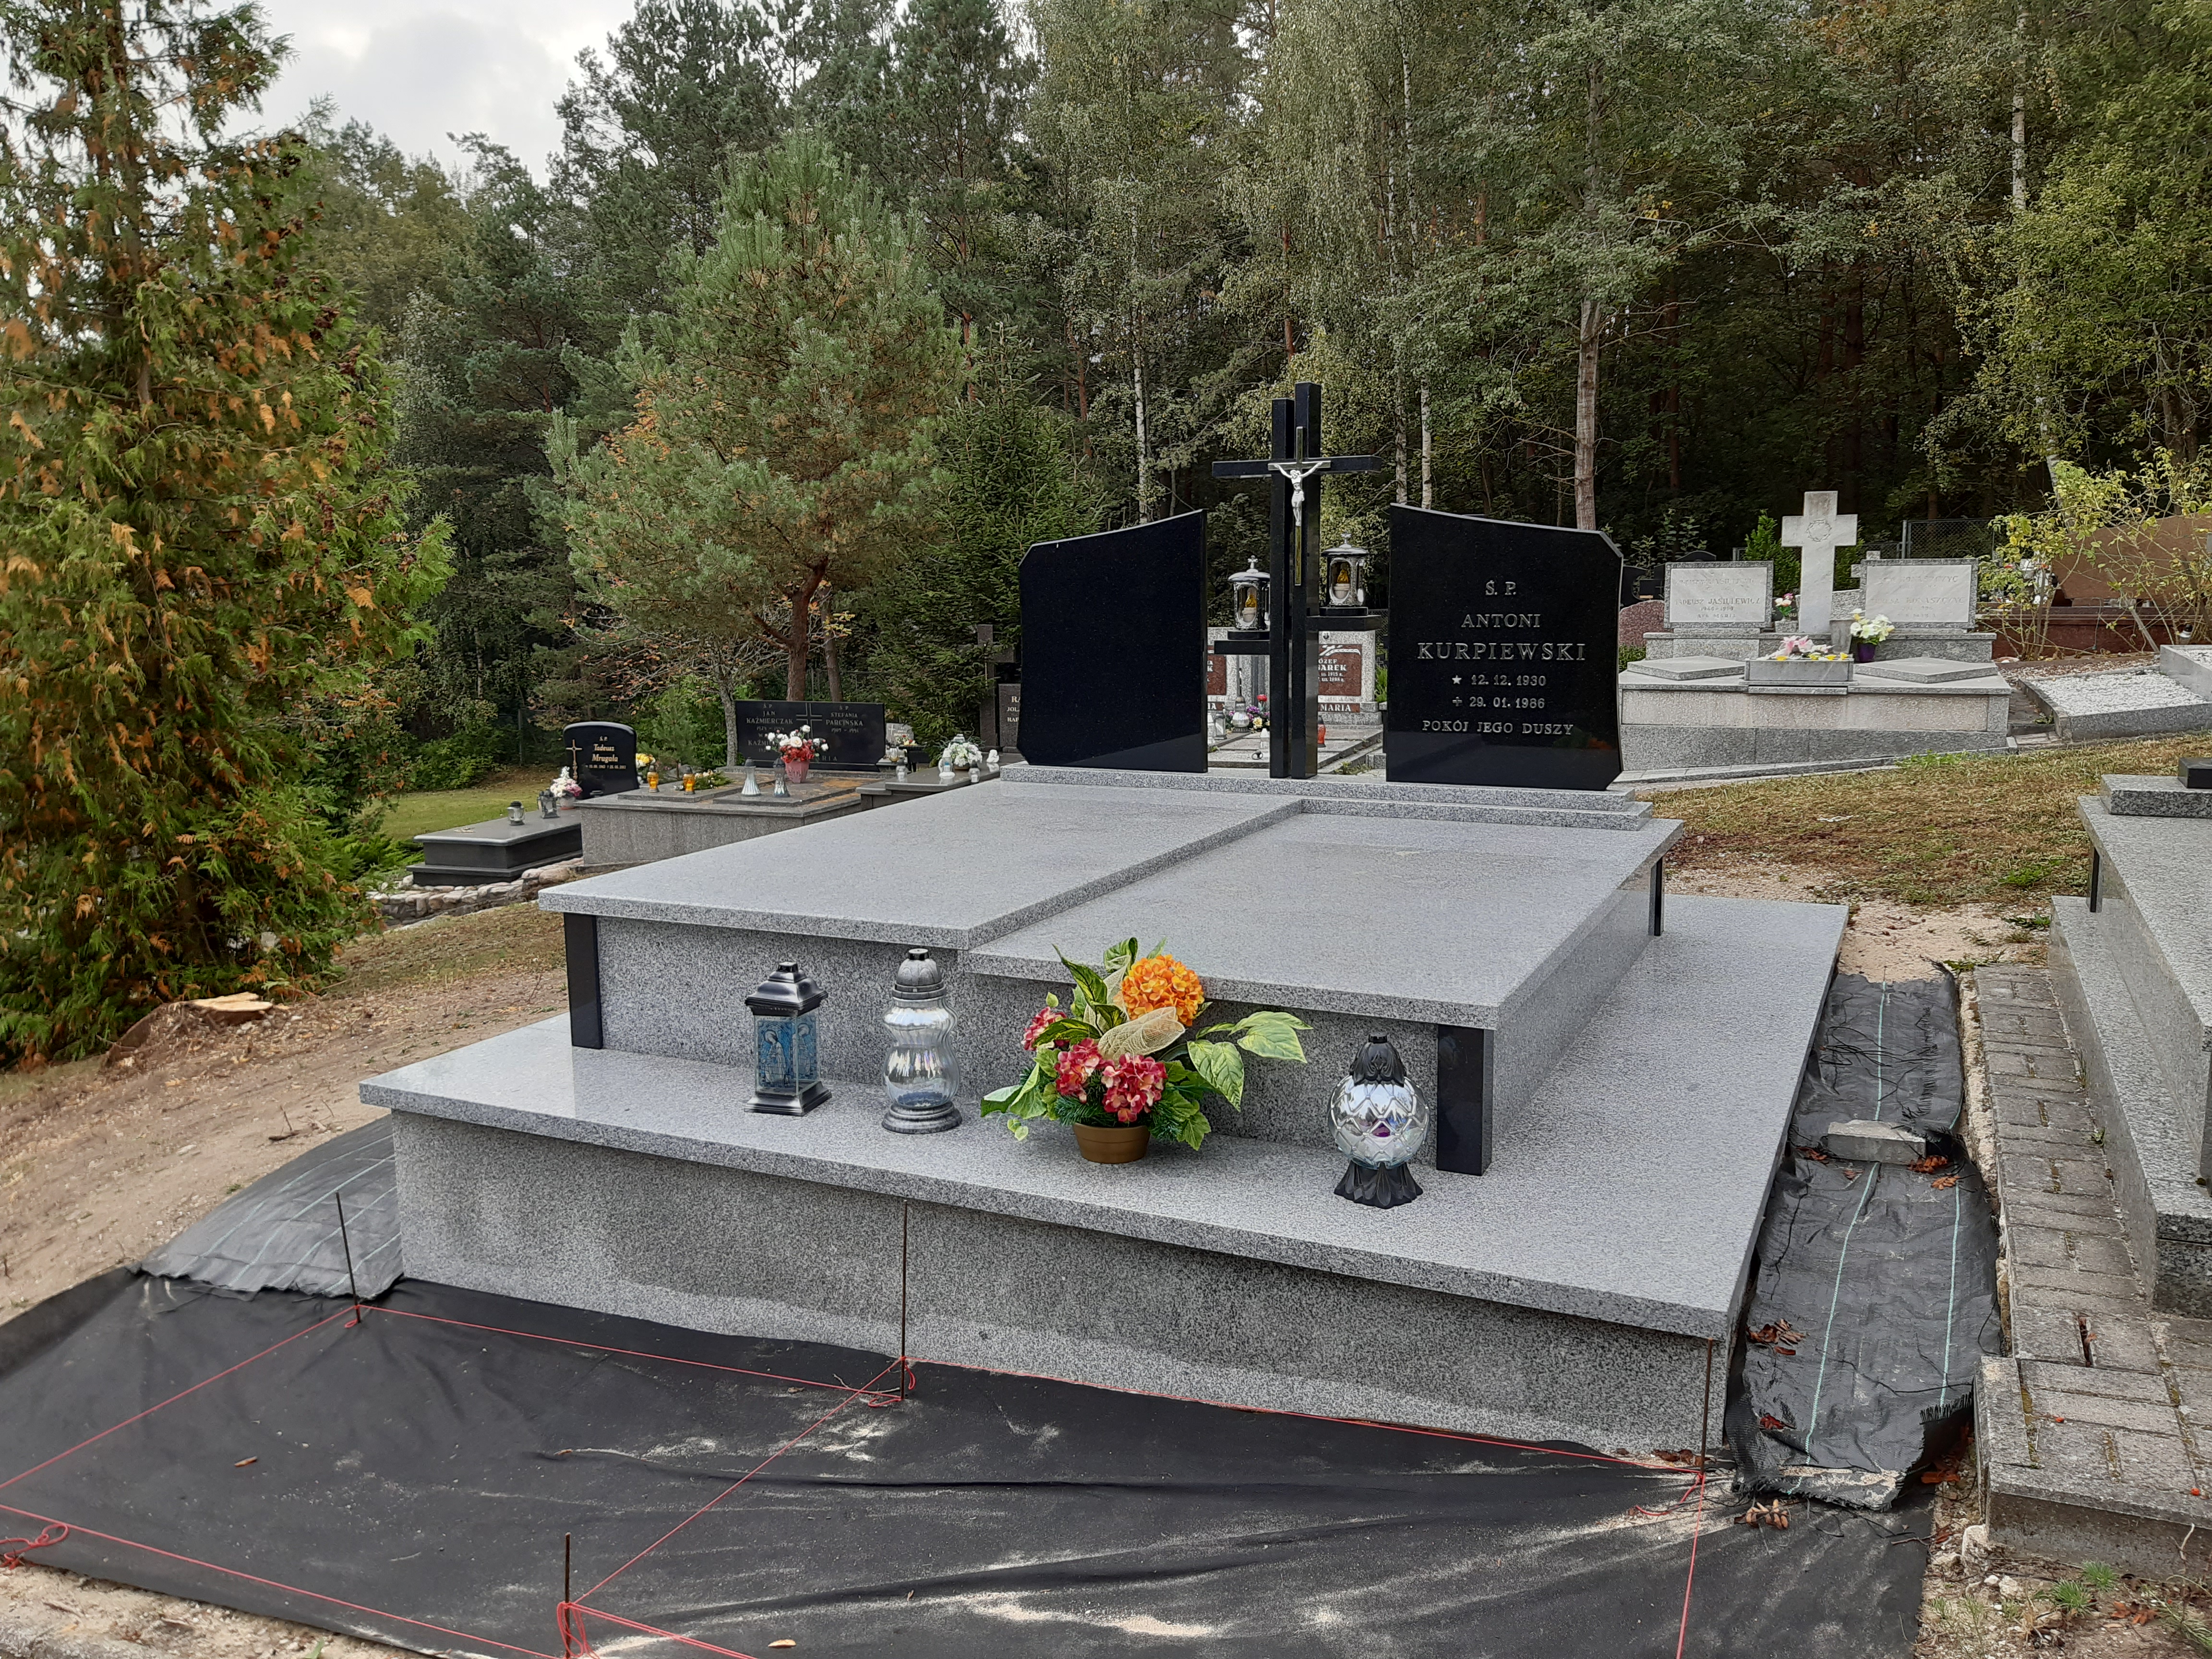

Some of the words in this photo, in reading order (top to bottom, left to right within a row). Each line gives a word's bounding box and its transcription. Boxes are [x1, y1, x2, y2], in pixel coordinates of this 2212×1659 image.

[1504, 581, 1516, 595] P.
[1461, 614, 1541, 628] ANTONI
[1417, 643, 1586, 661] KURPIEWSKI
[1471, 674, 1489, 685] 12.
[1493, 675, 1512, 686] 12.
[1516, 675, 1547, 686] 1930
[1320, 704, 1351, 712] MARIA
[1469, 697, 1487, 708] 29.
[1493, 697, 1511, 708] 01.
[1515, 697, 1545, 709] 1986
[1422, 720, 1469, 732] POKÓJ
[1477, 721, 1513, 733] JEGO
[1522, 723, 1574, 735] DUSZY
